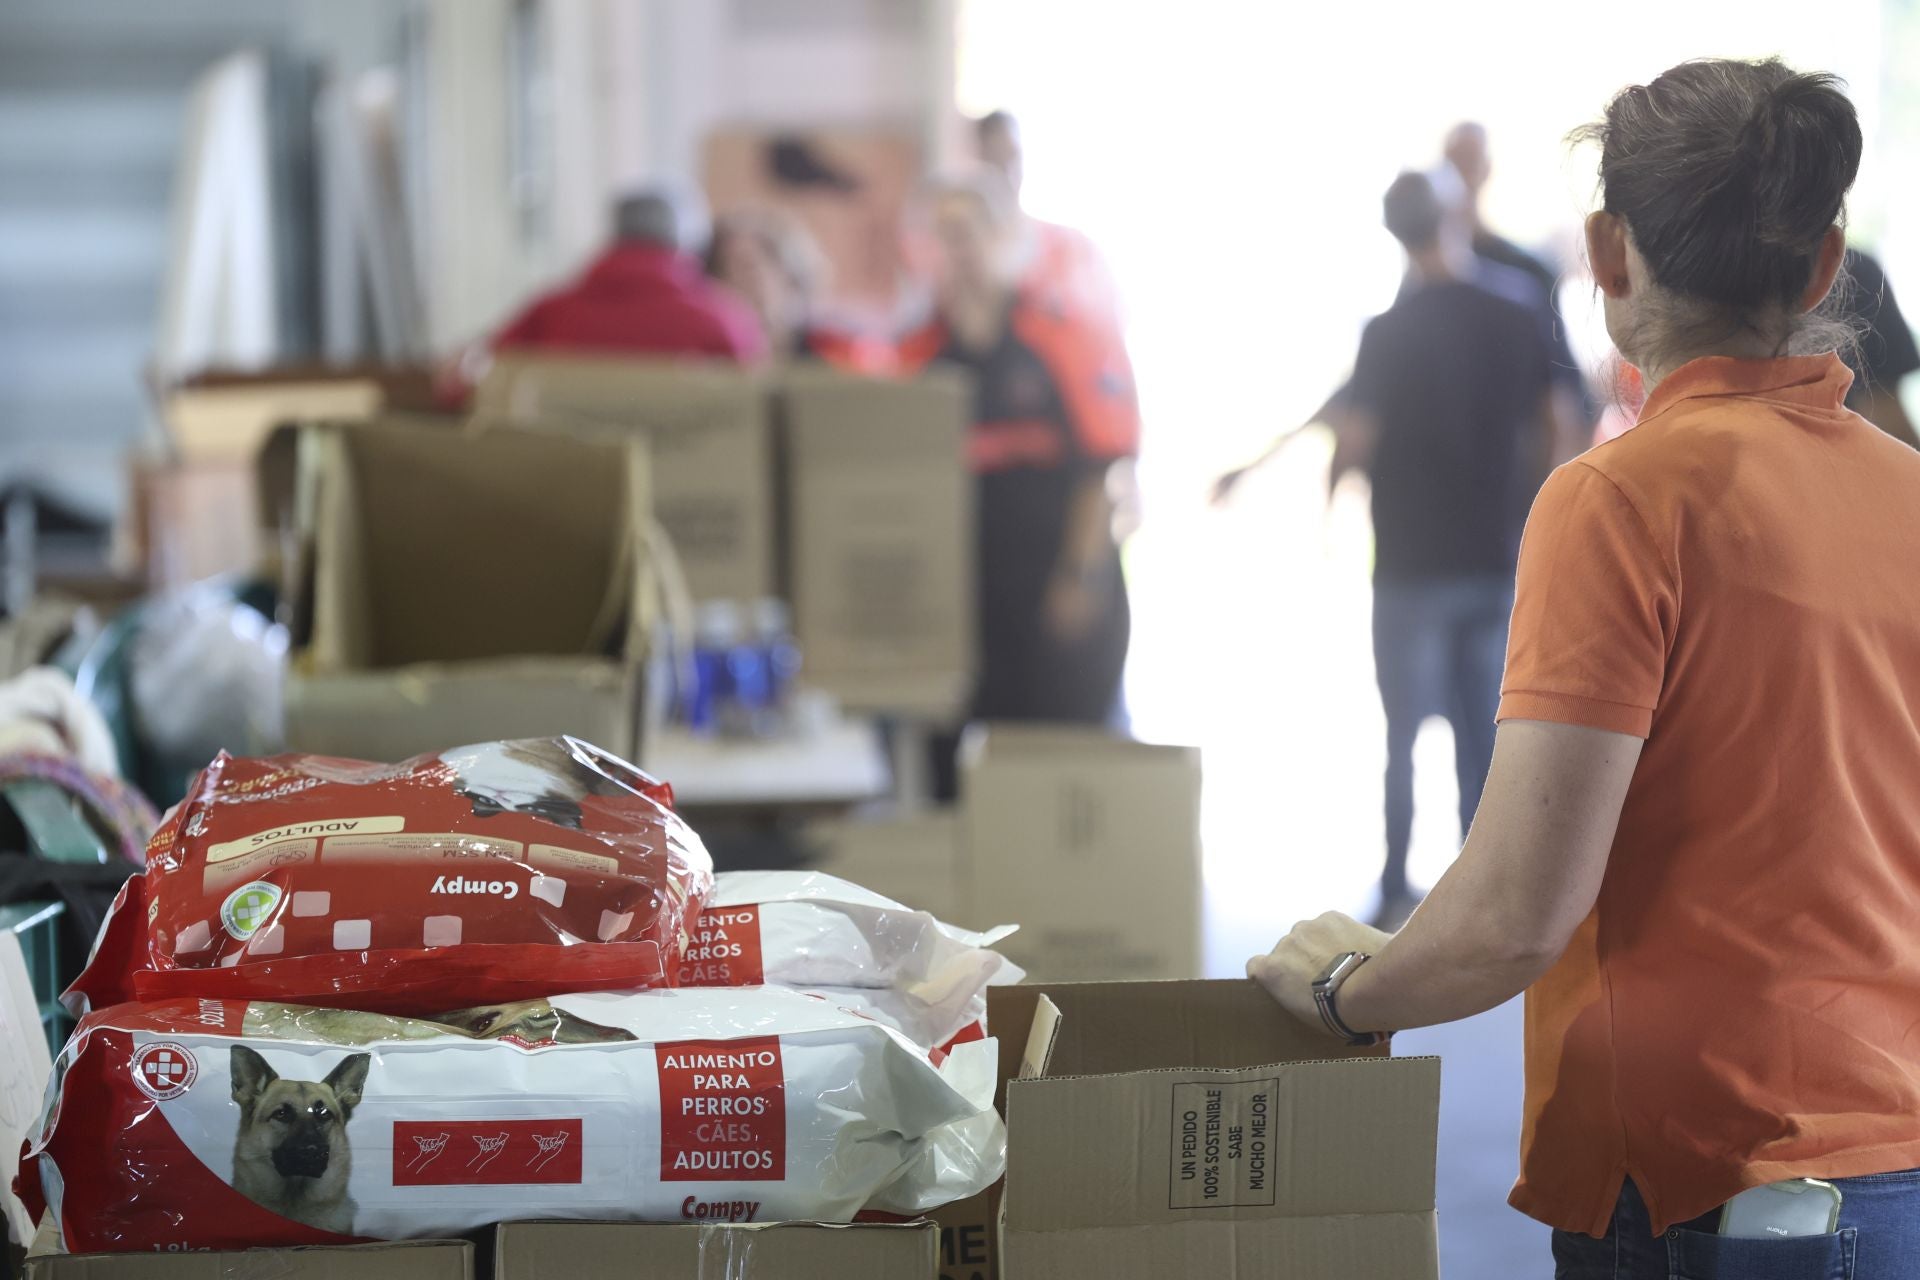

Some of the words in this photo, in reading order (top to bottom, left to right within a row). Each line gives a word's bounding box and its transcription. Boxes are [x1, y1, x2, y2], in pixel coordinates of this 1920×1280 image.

[251, 822, 359, 846] ADULTOS
[430, 876, 519, 900] Compy
[698, 912, 753, 928] ENTO
[690, 929, 728, 944] ARA
[686, 943, 742, 961] RROS
[663, 1051, 776, 1069] ALIMENTO
[693, 1074, 751, 1090] PARA
[682, 1096, 765, 1116] PERROS
[1251, 1094, 1268, 1138] MEJOR
[696, 1119, 752, 1143] CÃES
[1182, 1110, 1198, 1159] PEDIDO
[1204, 1090, 1222, 1164] SOSTENIBLE
[1228, 1126, 1243, 1159] SABE
[673, 1150, 773, 1169] ADULTOS
[1181, 1161, 1197, 1181] UN
[1249, 1141, 1266, 1190] MUCHO
[1203, 1165, 1220, 1199] 100%
[681, 1195, 761, 1222] Compy
